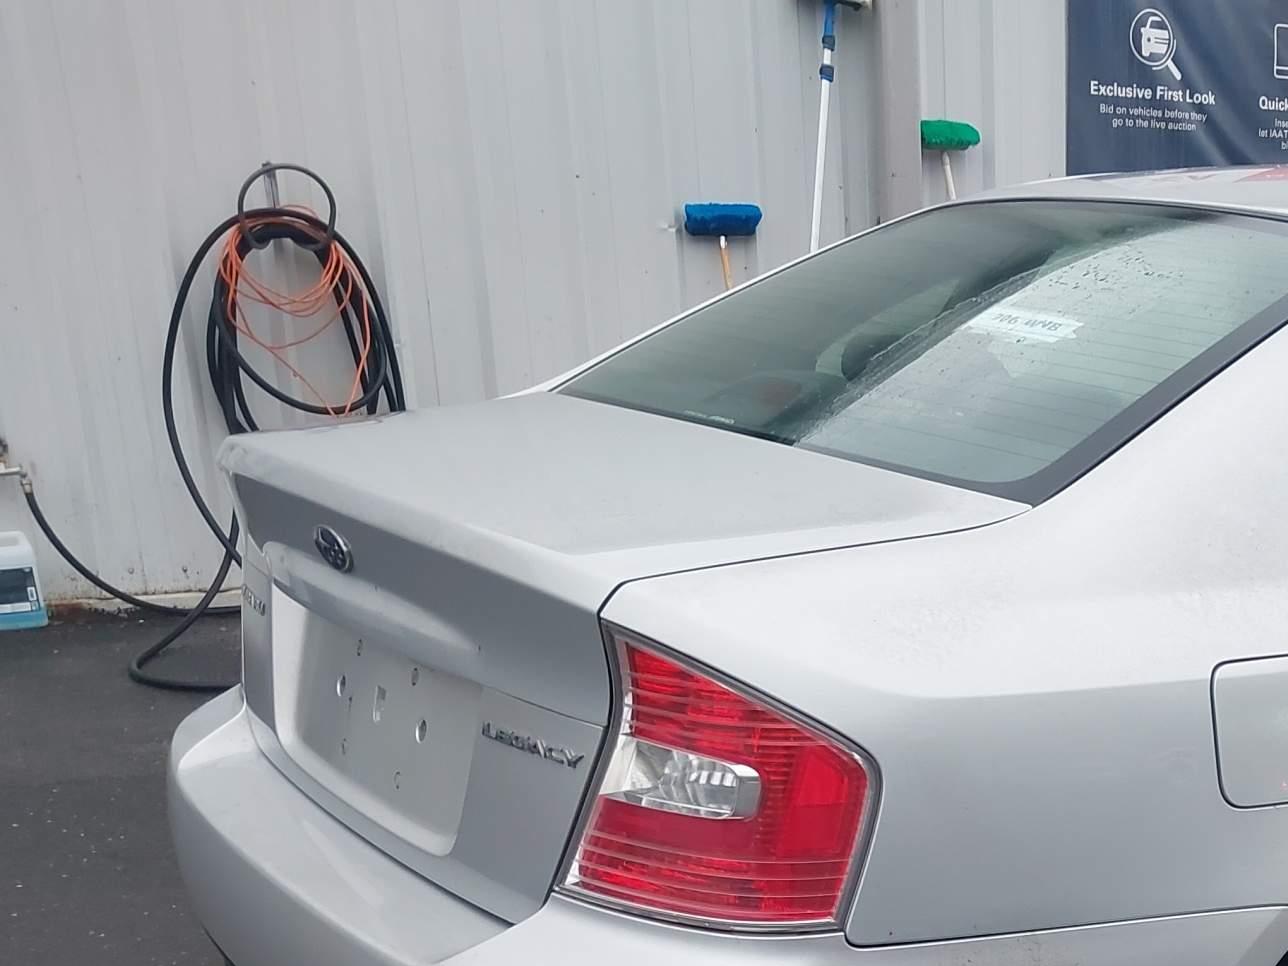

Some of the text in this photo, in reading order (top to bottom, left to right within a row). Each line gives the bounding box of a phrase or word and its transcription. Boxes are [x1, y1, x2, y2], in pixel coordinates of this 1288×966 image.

[1090, 80, 1216, 105] Exclusive First Look
[1100, 103, 1207, 122] Bid on vehicles before they
[1112, 118, 1196, 131] go to the live auction
[1258, 128, 1267, 138] let
[1270, 129, 1283, 139] IAA
[481, 720, 585, 769] LEGACY
